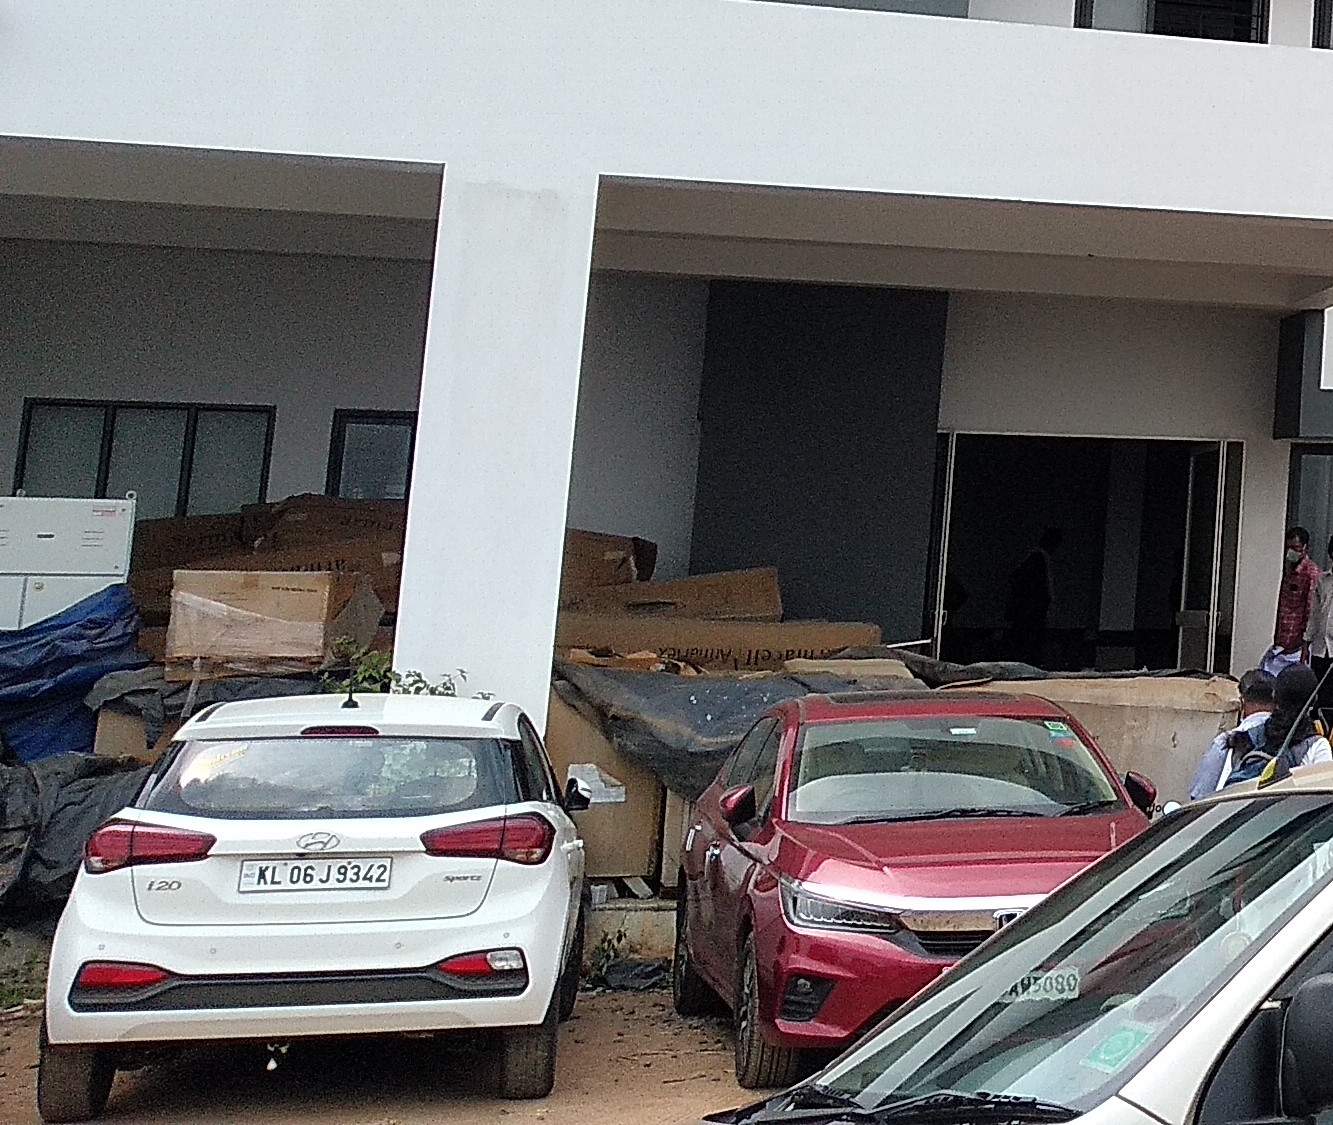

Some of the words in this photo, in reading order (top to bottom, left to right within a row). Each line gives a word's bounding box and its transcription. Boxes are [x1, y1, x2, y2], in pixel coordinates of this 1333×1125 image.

[256, 865, 282, 886] KL
[289, 864, 315, 885] 06
[335, 863, 388, 884] 9342
